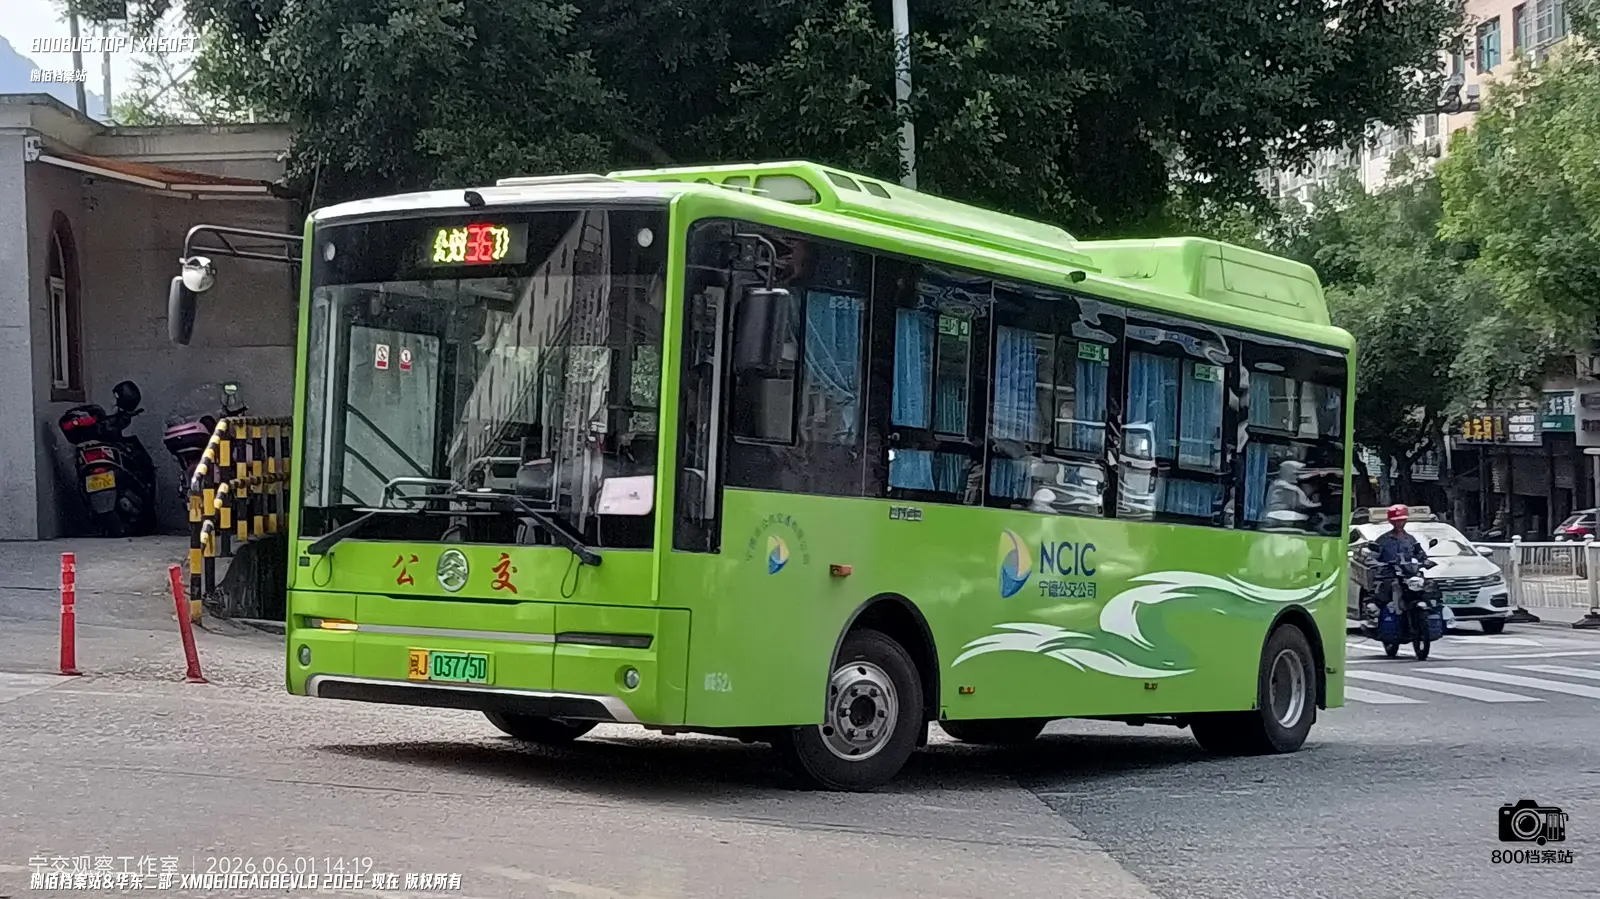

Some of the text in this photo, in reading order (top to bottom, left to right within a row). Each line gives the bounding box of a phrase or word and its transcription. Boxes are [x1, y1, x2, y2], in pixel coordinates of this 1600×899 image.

[392, 552, 518, 594] 公 交
[1040, 541, 1096, 576] NCIC
[1039, 580, 1097, 598] 宁德公交公司
[434, 654, 487, 679] 03775D
